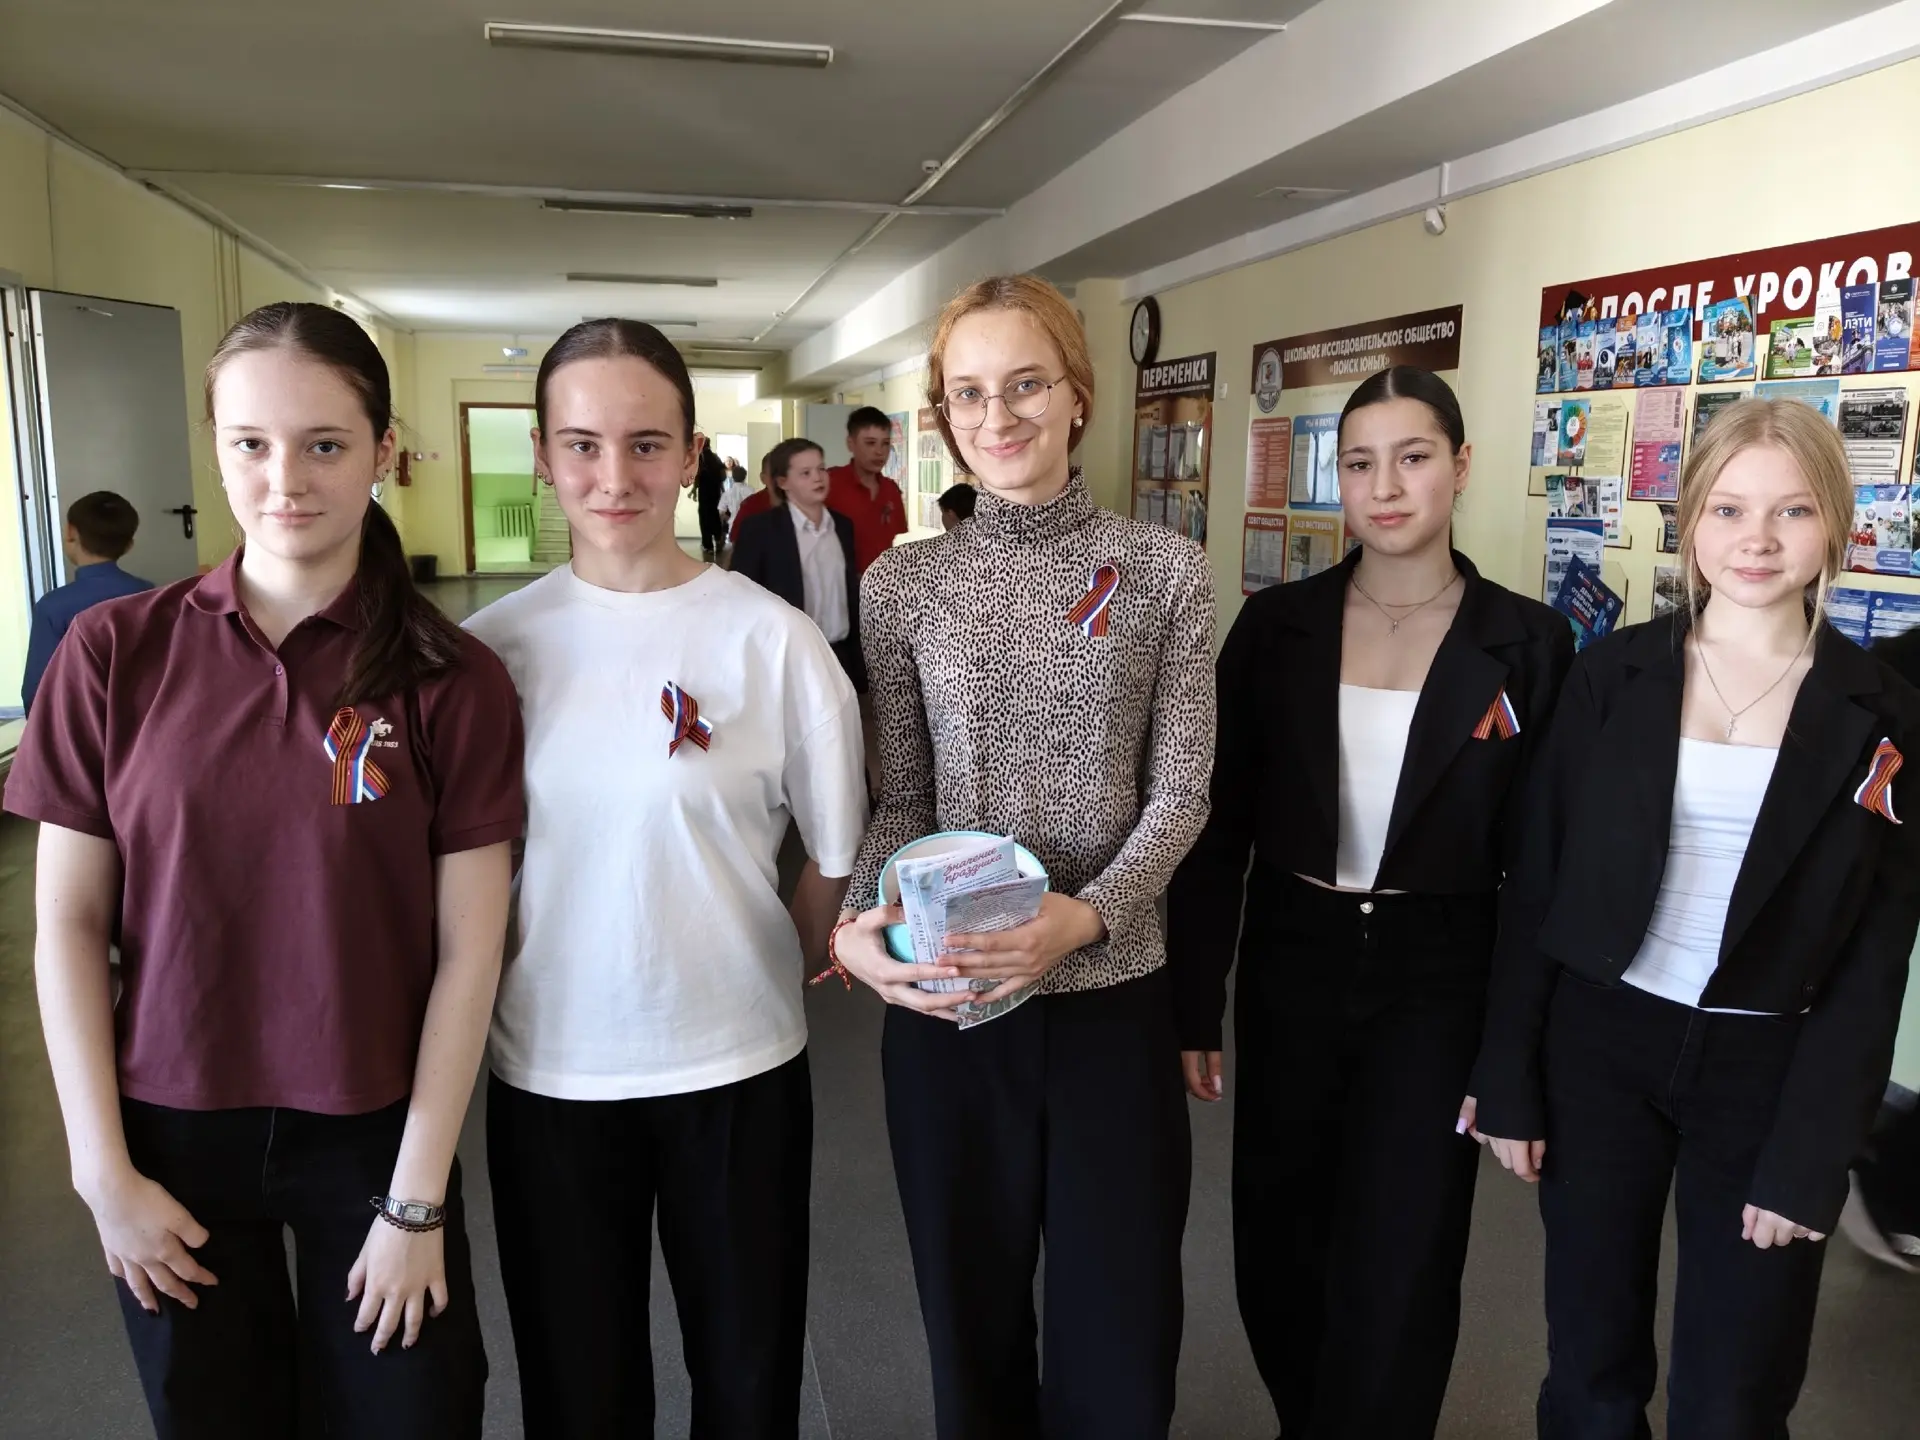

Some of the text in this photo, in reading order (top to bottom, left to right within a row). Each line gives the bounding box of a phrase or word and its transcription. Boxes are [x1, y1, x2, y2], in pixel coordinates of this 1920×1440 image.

[1844, 316, 1872, 330] ЛЭТИ
[1283, 320, 1455, 363] ШКОЛЬНОЕ ИССЛЕДОВАТЕЛЬСКОЕ ОБЩЕСТВО
[1142, 358, 1208, 389] ПЕРЕМЕНКА
[943, 847, 997, 876] Значение
[943, 853, 1003, 884] праздника
